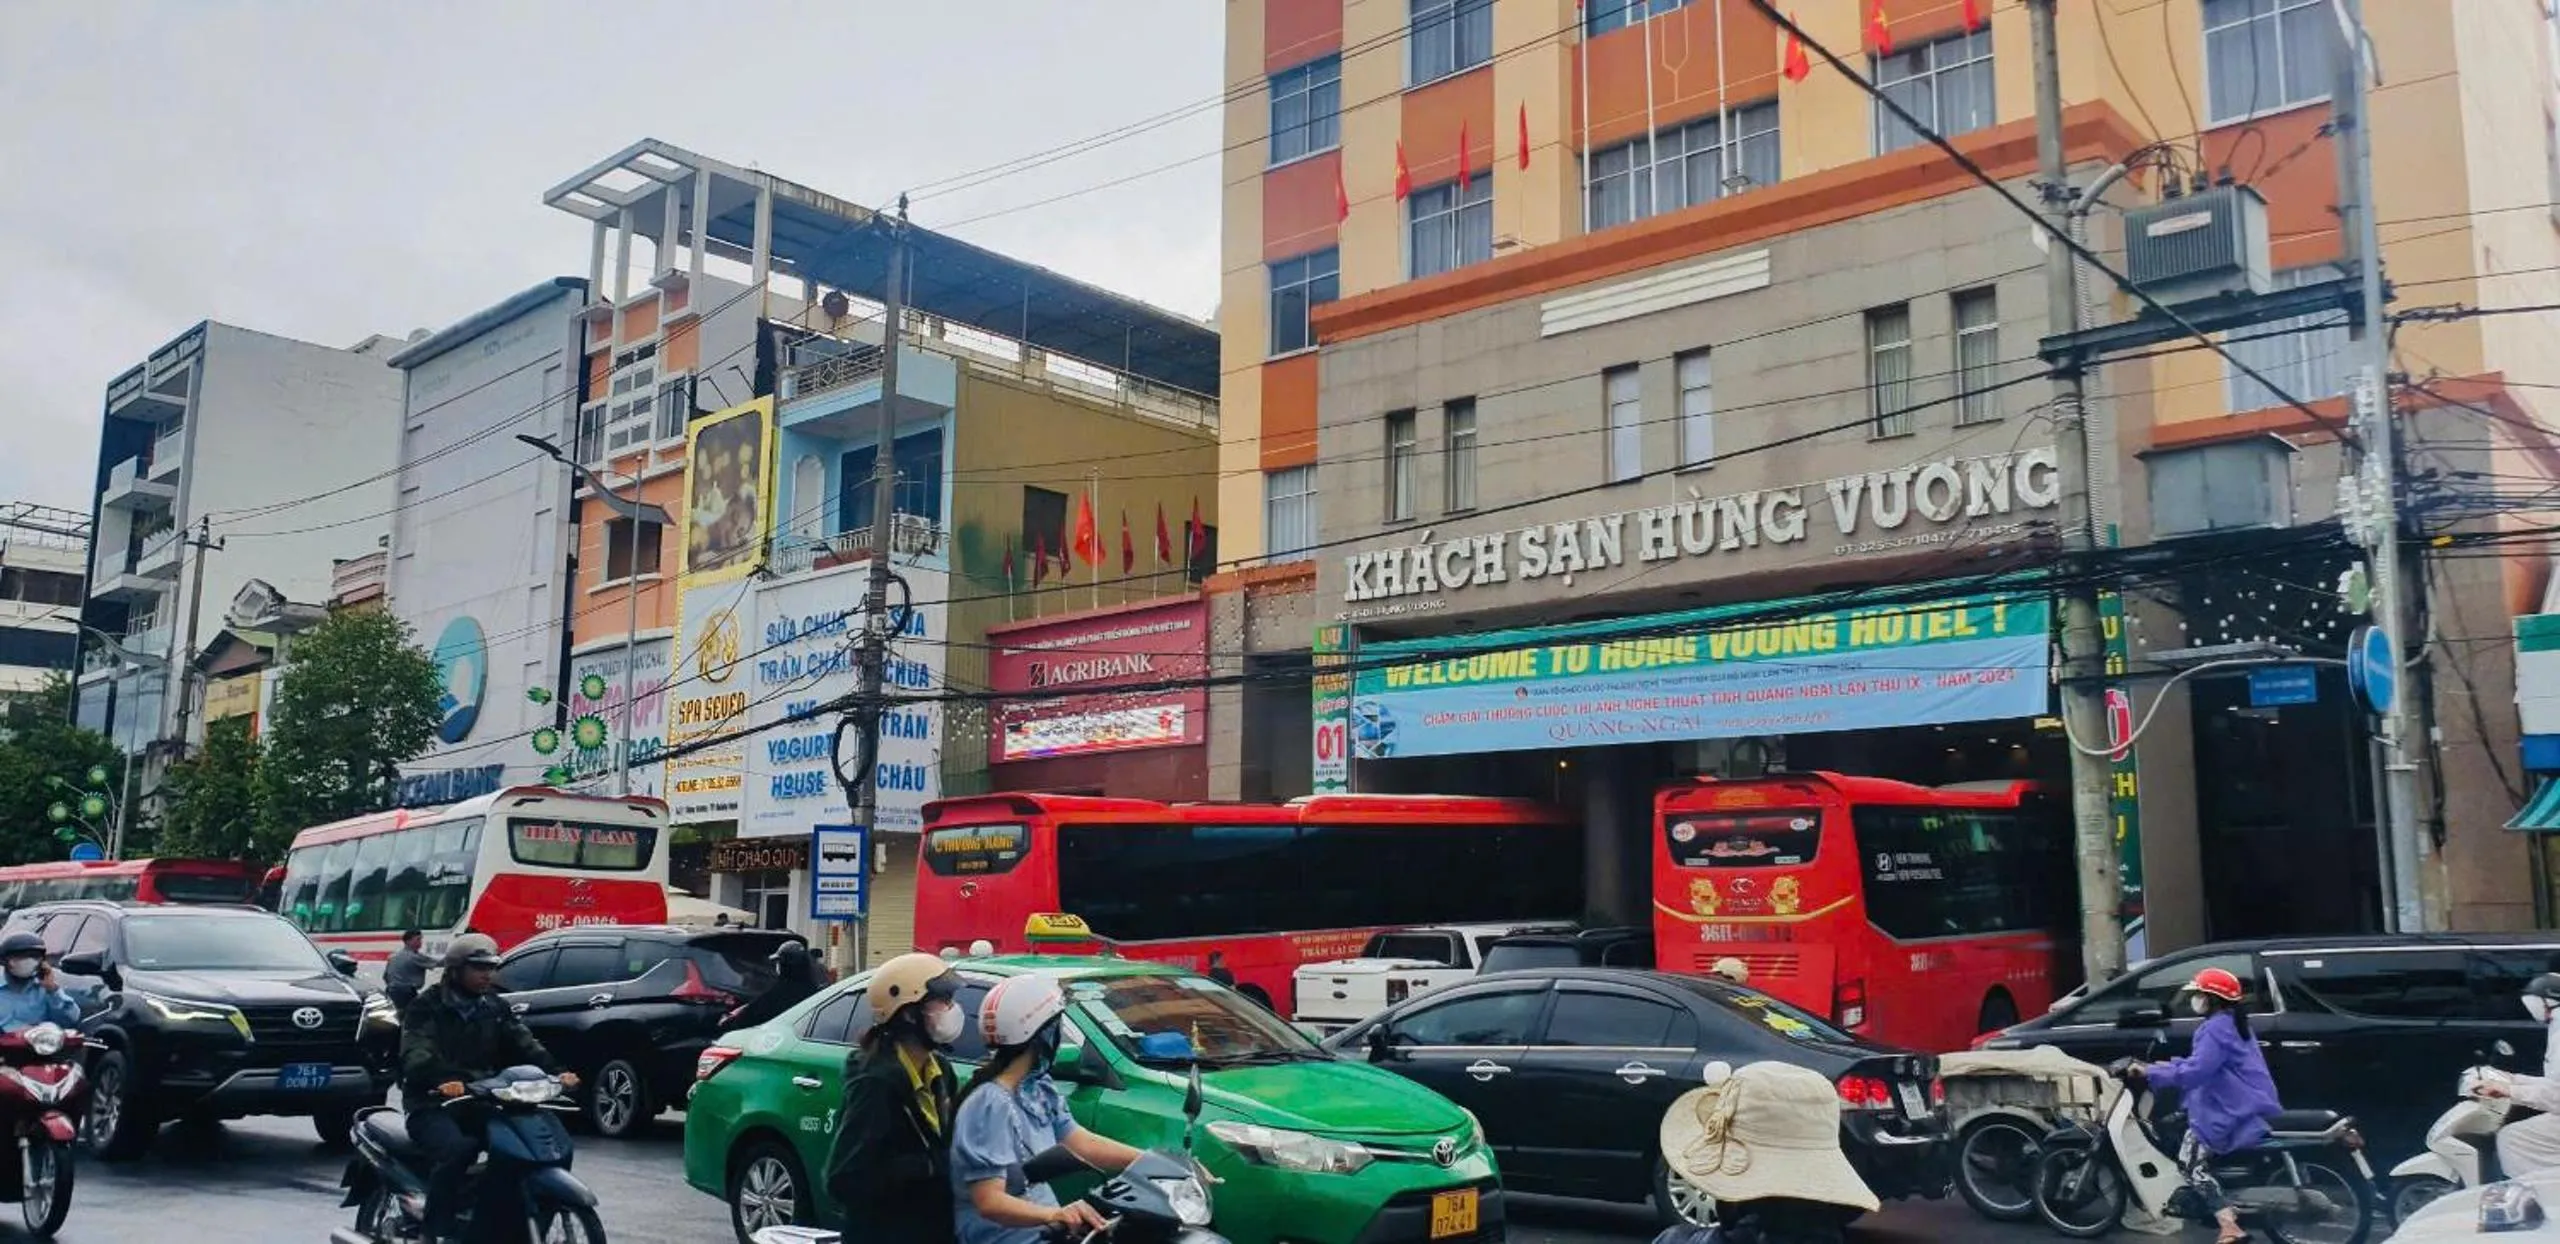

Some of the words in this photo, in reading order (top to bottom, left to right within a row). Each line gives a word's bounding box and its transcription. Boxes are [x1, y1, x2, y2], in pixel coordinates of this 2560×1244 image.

[1345, 530, 1507, 601] KHÁCH
[1519, 515, 1624, 586] SẠN
[1638, 486, 1808, 561] HÙNG
[1386, 648, 1538, 688] WELCOME
[1549, 644, 1591, 675] TO
[1851, 600, 1978, 646] HOTEL
[1050, 654, 1153, 685] AGRIBANK
[678, 699, 701, 725] SPA
[1316, 724, 1345, 762] 01
[771, 770, 825, 797] HOUSE
[876, 759, 926, 792] CHÂU
